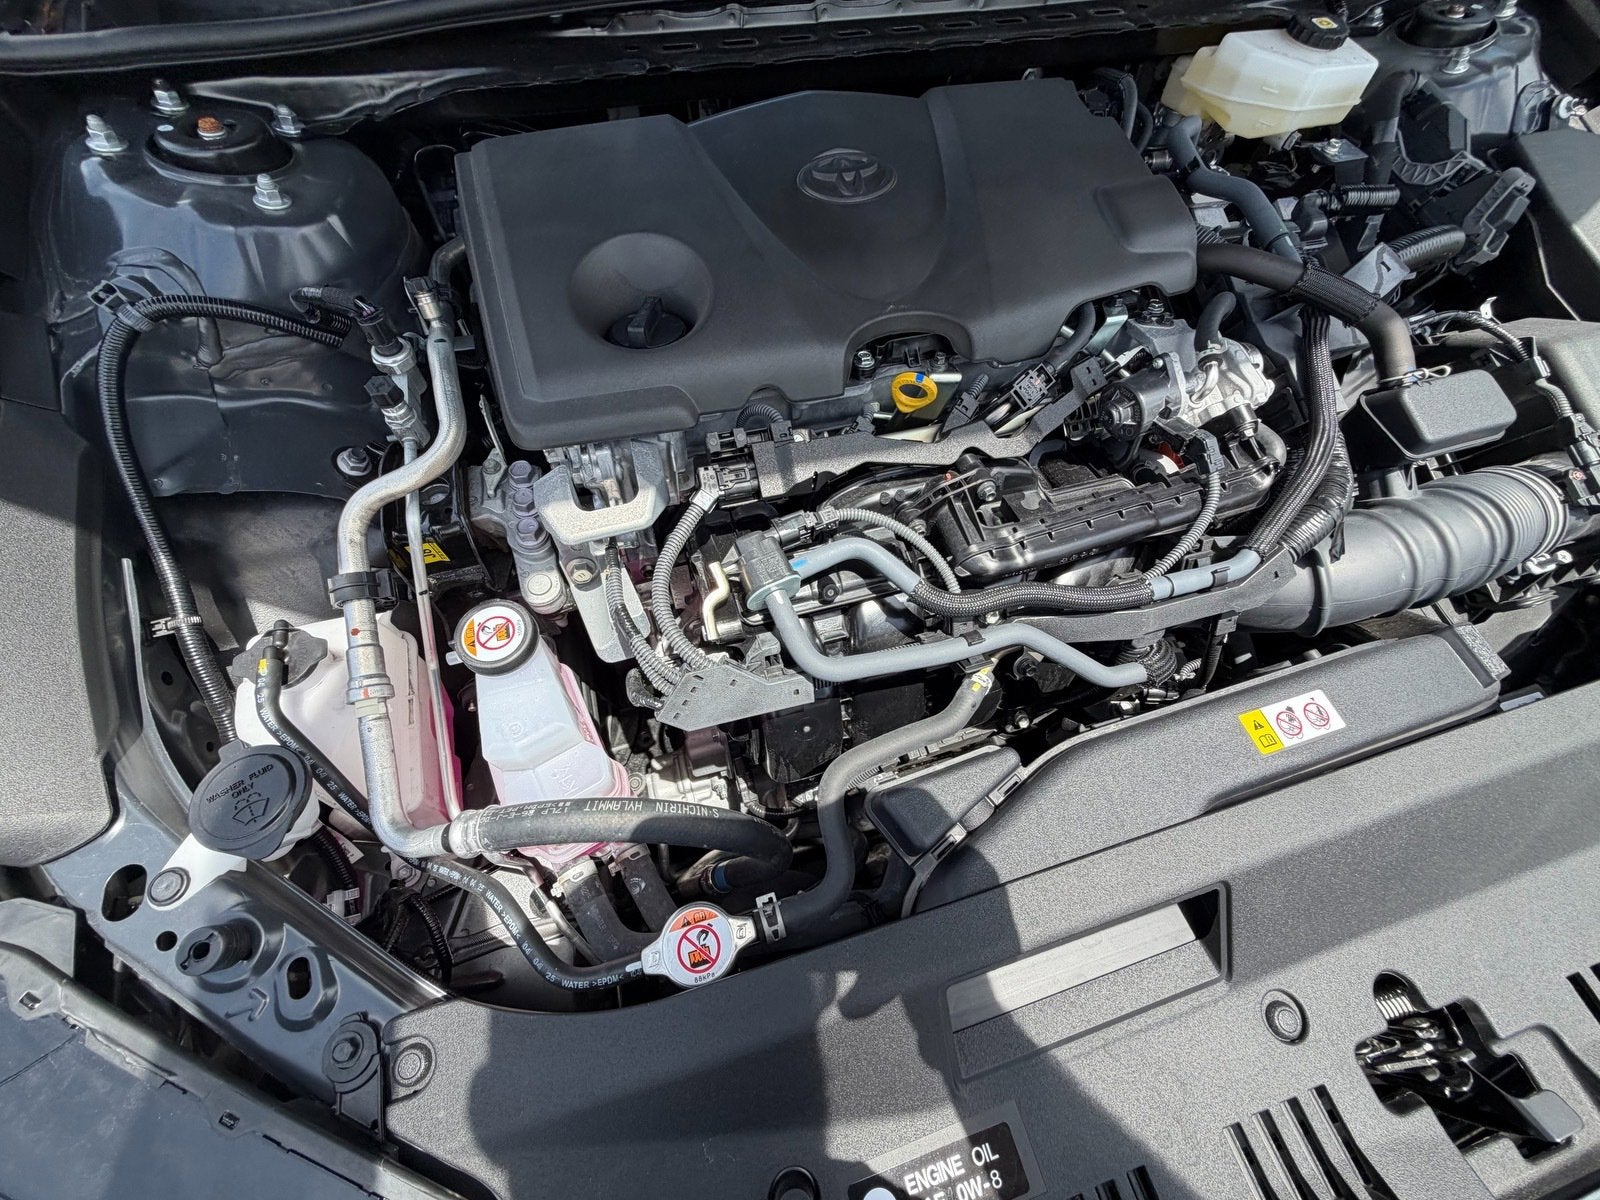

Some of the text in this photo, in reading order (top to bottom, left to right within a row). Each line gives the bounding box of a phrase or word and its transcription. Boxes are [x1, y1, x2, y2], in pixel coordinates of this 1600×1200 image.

[260, 708, 279, 731] WATER
[206, 764, 274, 804] WASHER FLUID
[231, 782, 254, 799] ONLY
[485, 890, 503, 913] WATER
[561, 979, 590, 989] WATER
[903, 1142, 1000, 1196] ENGINE OIL
[956, 1169, 1003, 1200] 0W-8
